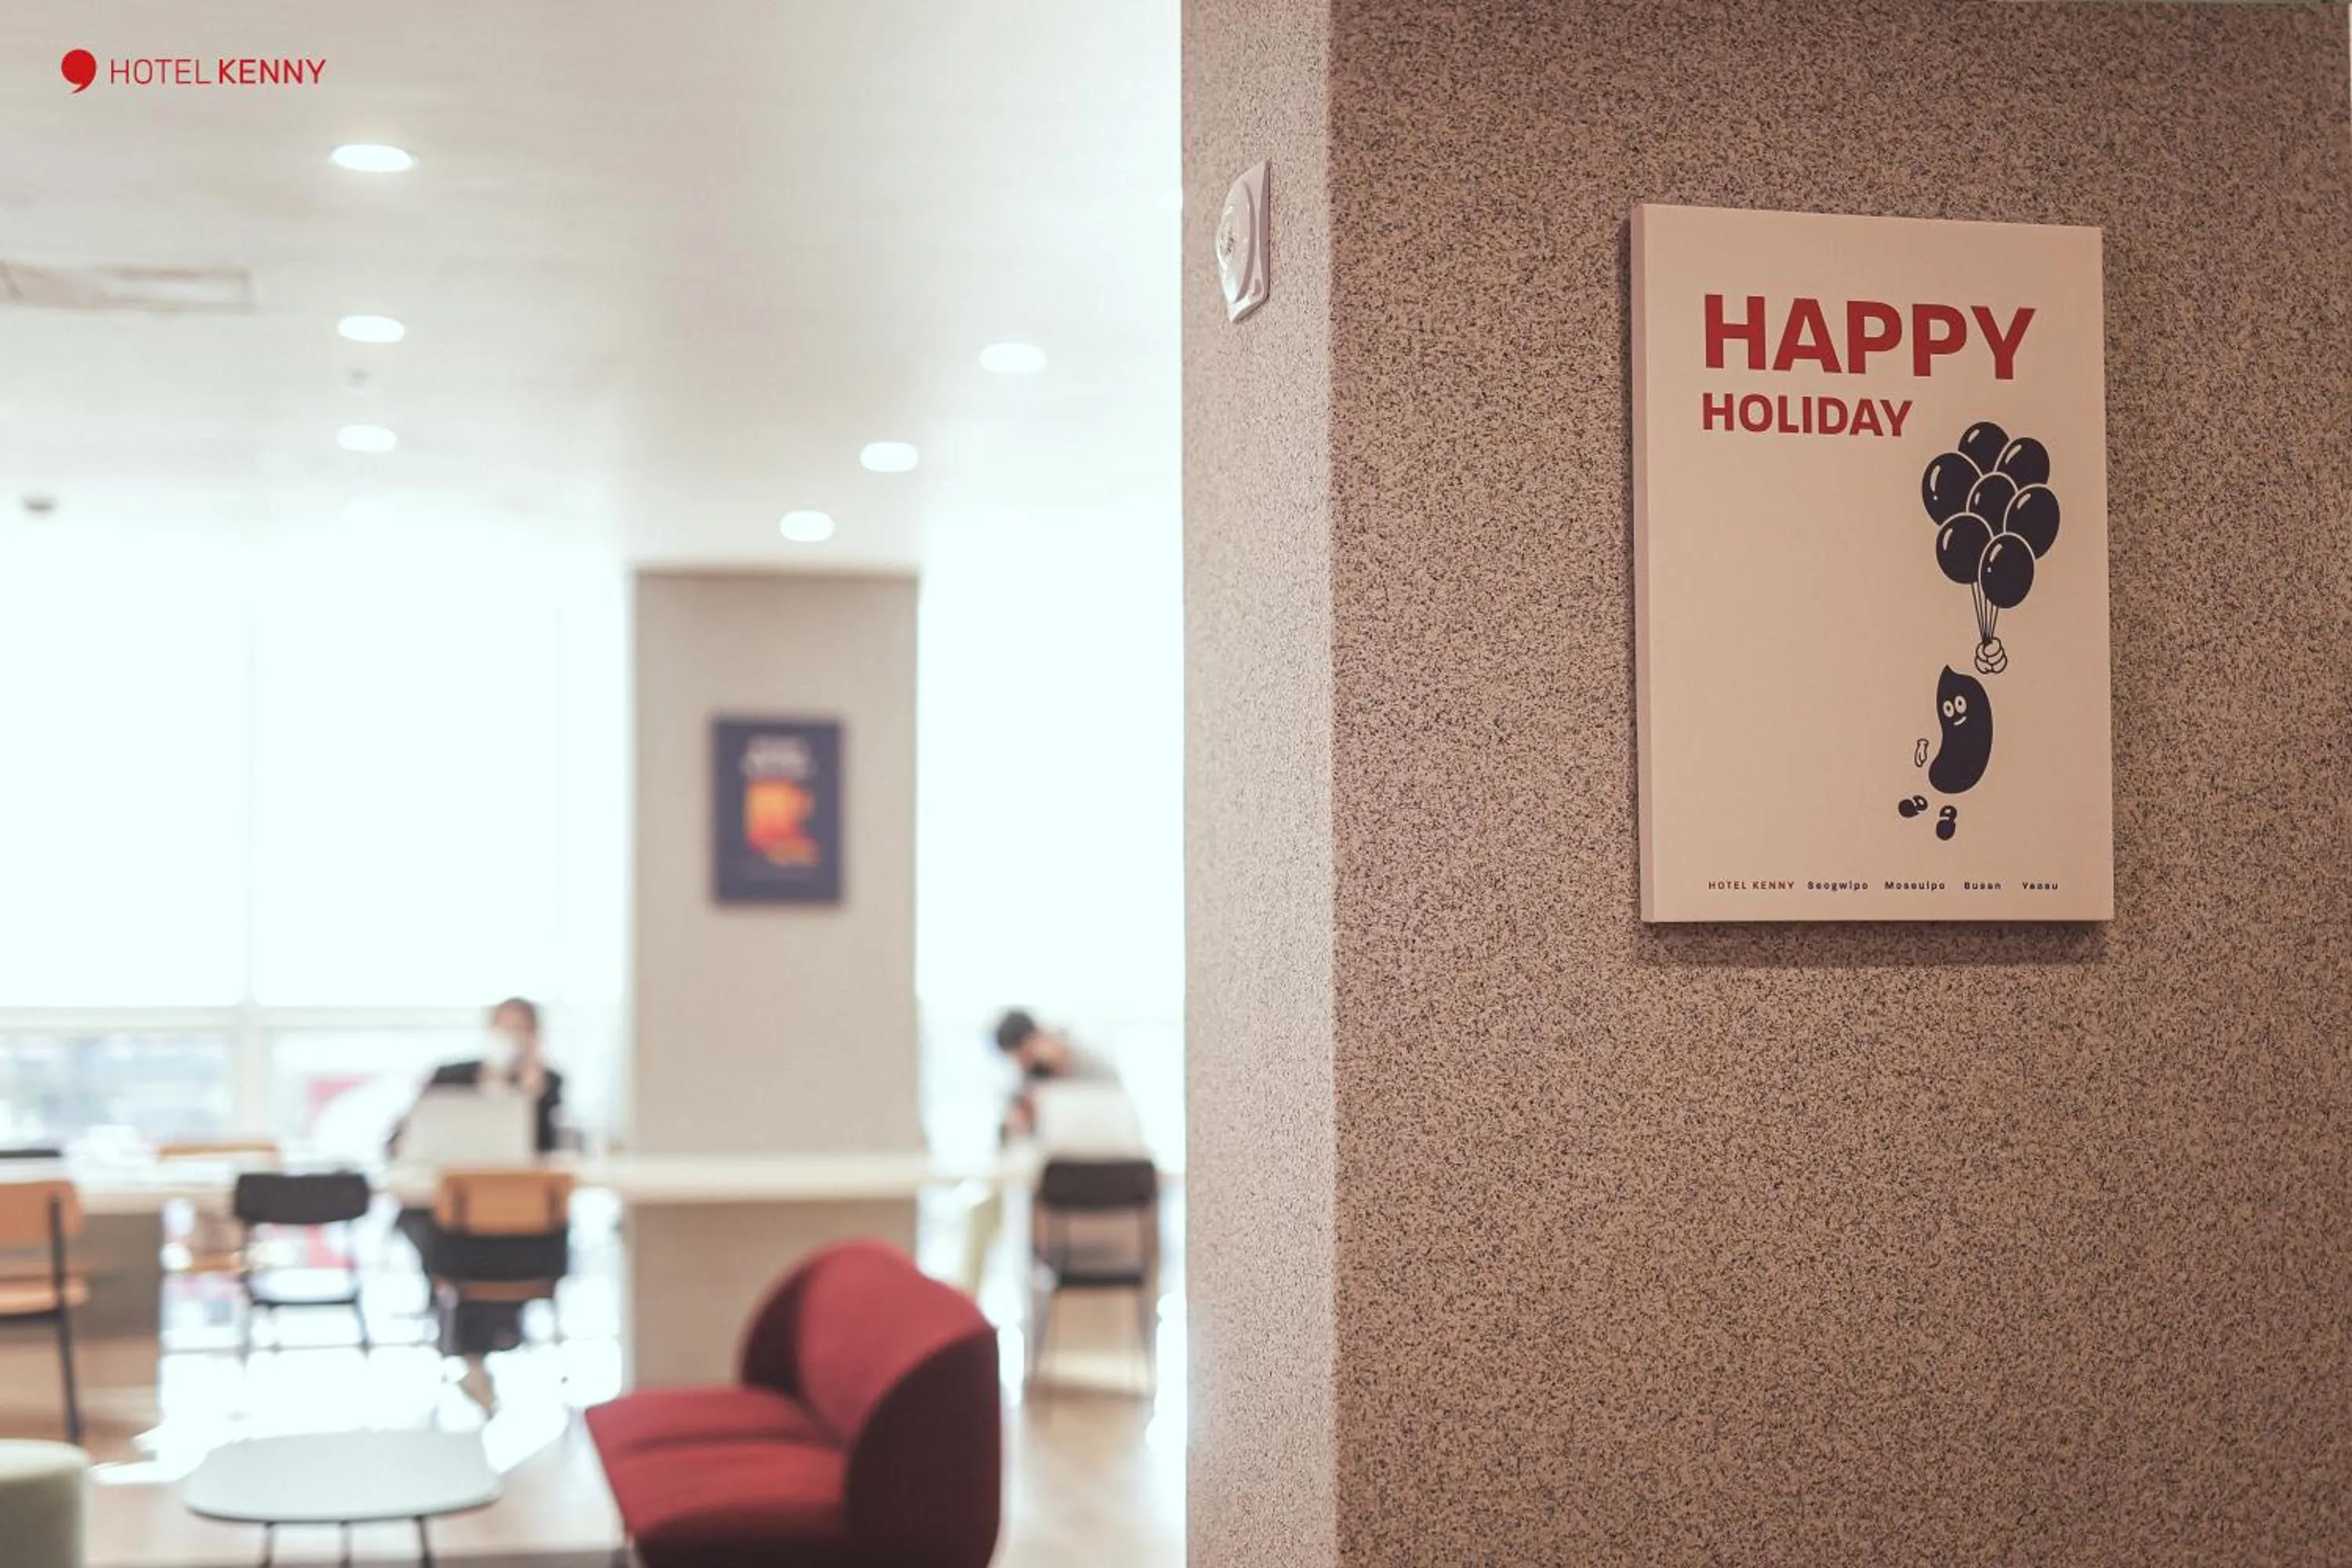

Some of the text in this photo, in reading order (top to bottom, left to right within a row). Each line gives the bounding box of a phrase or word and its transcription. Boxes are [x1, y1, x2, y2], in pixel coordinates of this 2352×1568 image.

[1704, 294, 2037, 380] HAPPY
[1702, 393, 1913, 437] HOLIDAY
[1708, 880, 1748, 891] HOTEL
[1751, 880, 1795, 891] KENNY
